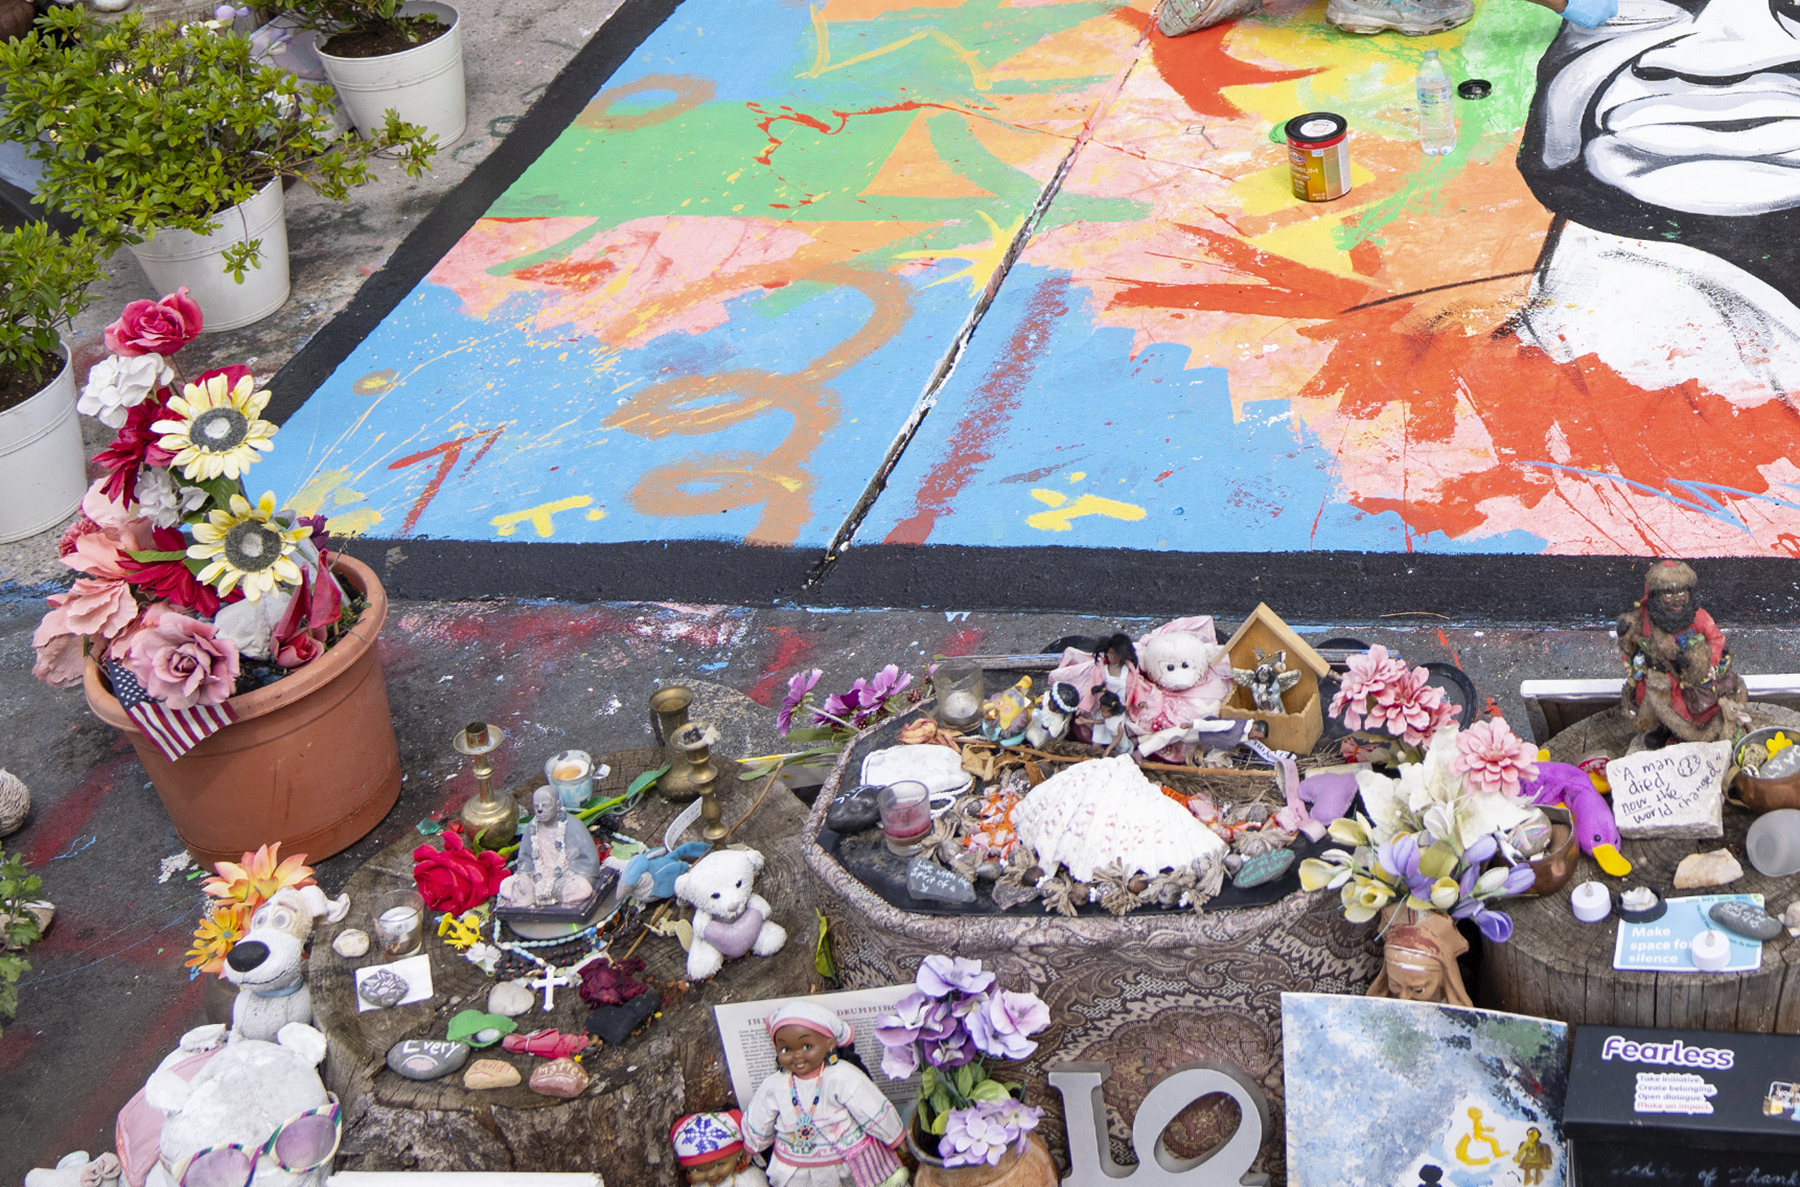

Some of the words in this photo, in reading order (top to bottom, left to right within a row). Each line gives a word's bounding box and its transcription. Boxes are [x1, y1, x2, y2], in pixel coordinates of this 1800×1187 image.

[1641, 757, 1675, 774] man
[1622, 797, 1648, 814] now
[1656, 788, 1681, 803] the
[1633, 803, 1673, 824] world
[936, 879, 951, 889] of
[1631, 926, 1671, 937] Make
[1629, 940, 1671, 951] space
[1673, 938, 1692, 950] for
[1628, 953, 1679, 963] silence
[402, 1039, 461, 1059] Every
[1604, 1037, 1735, 1069] Fearless
[1639, 1075, 1660, 1083] Take
[1662, 1075, 1703, 1084] initiative.
[1638, 1084, 1667, 1092] Create
[1669, 1084, 1713, 1094] belonging.
[1638, 1092, 1662, 1101] Open
[1663, 1093, 1704, 1102] dialogue.
[1637, 1101, 1663, 1109] Make
[1679, 1102, 1711, 1112] impact.
